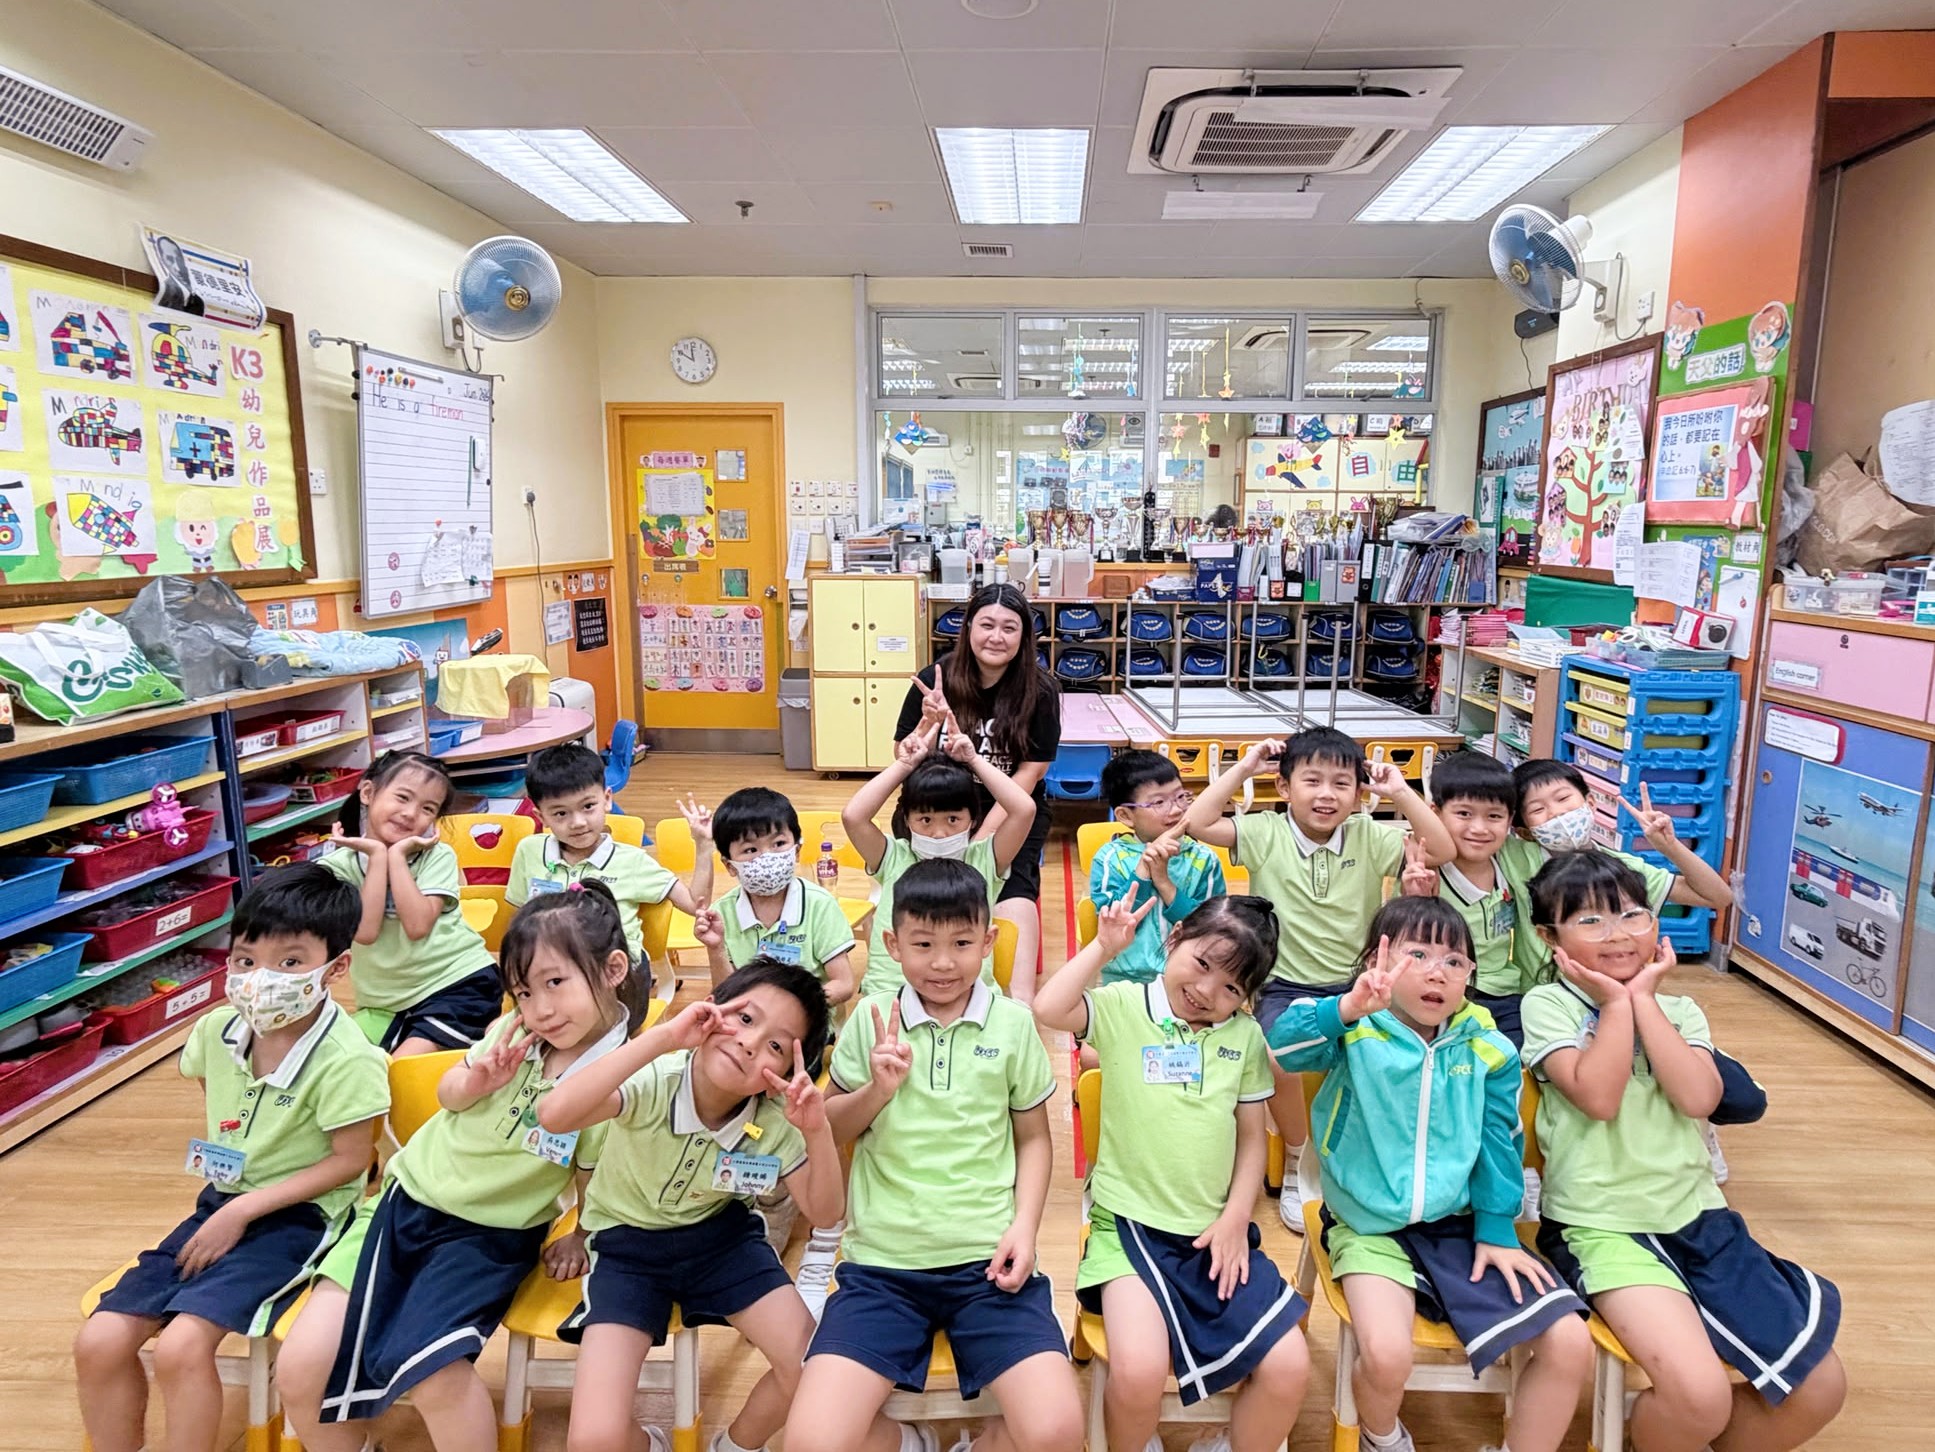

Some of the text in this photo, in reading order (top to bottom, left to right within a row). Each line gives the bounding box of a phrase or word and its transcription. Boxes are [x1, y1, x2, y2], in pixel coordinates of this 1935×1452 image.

[230, 346, 264, 380] K3
[1687, 350, 1742, 380] 天父的話
[372, 382, 388, 409] He
[293, 606, 318, 619] 玩具角
[1775, 666, 1816, 681] English corner
[157, 913, 188, 932] 2+6=
